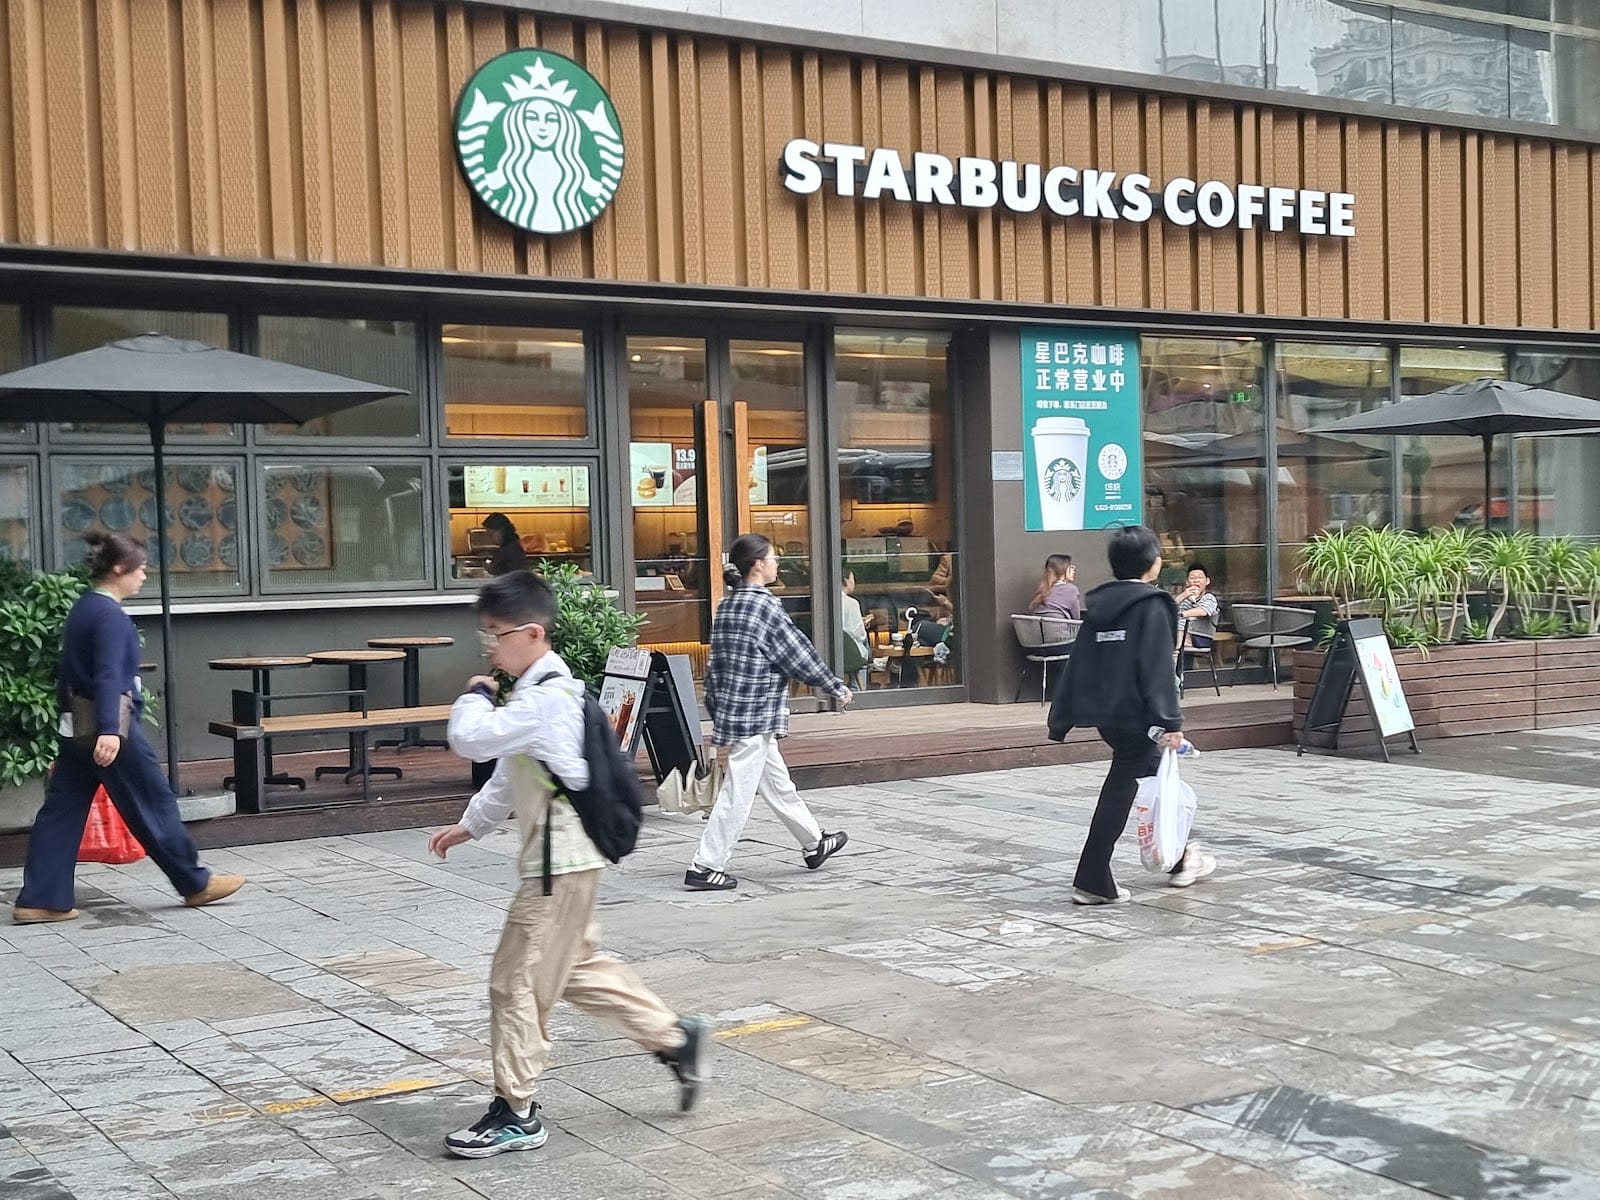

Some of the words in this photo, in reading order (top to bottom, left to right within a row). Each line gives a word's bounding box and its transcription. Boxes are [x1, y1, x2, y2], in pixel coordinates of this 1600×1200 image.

[783, 138, 1152, 223] STARBUCKS
[1163, 178, 1356, 237] COFFEE
[1035, 341, 1125, 366] 星巴克咖啡
[1035, 368, 1125, 393] 正常营业中
[675, 448, 696, 462] 13.9
